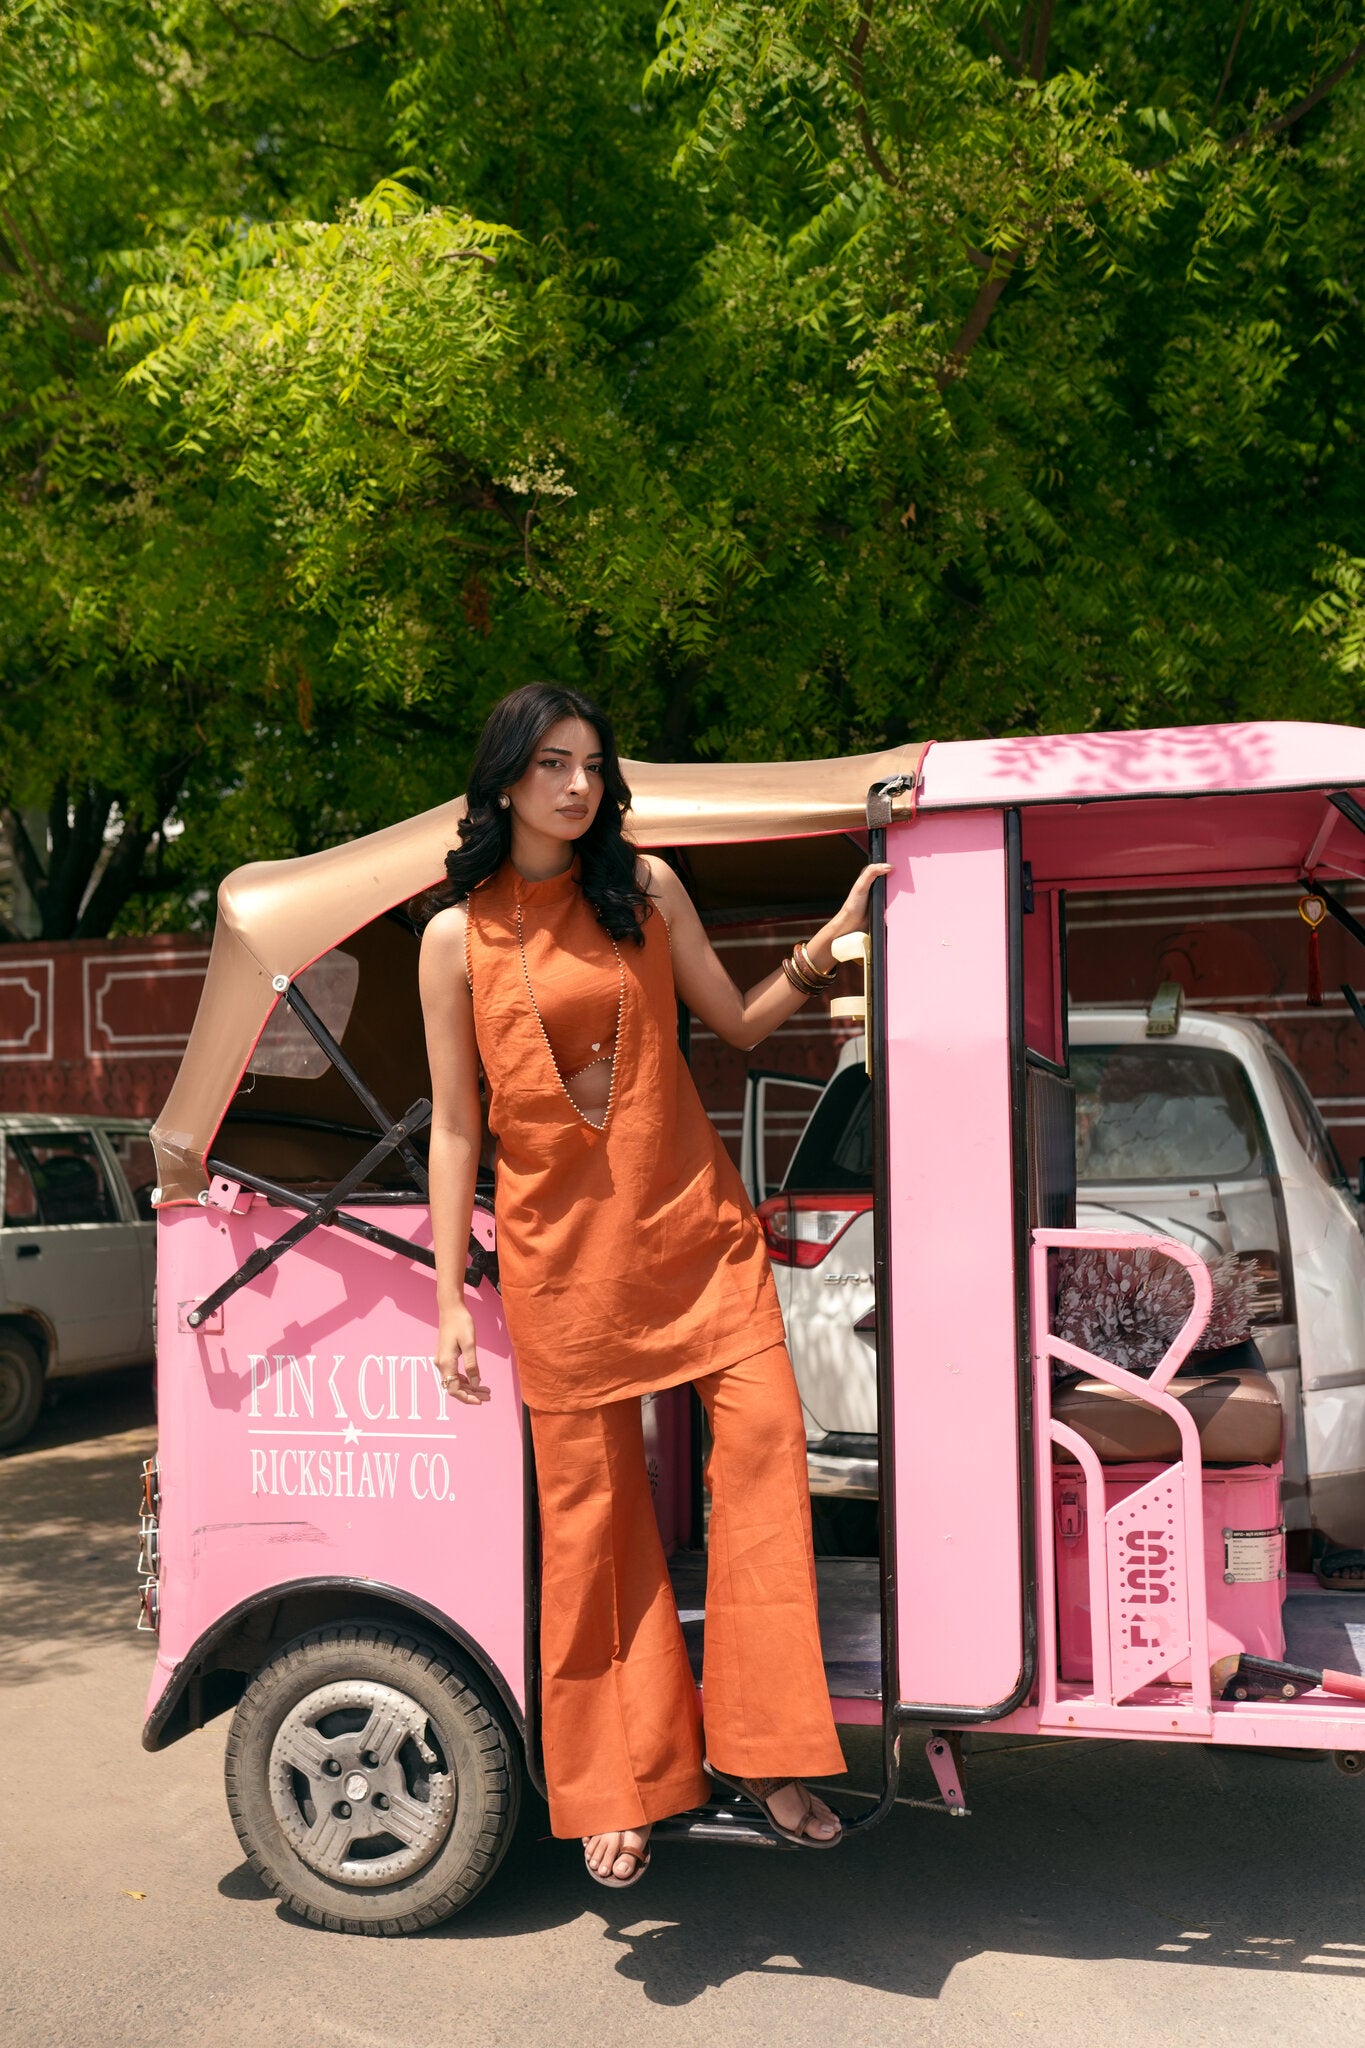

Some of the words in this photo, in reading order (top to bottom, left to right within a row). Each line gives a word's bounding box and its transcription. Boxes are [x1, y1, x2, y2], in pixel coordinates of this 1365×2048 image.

[358, 1354, 450, 1421] CITY
[250, 1449, 400, 1499] RICKSHAW
[409, 1452, 456, 1502] CO.
